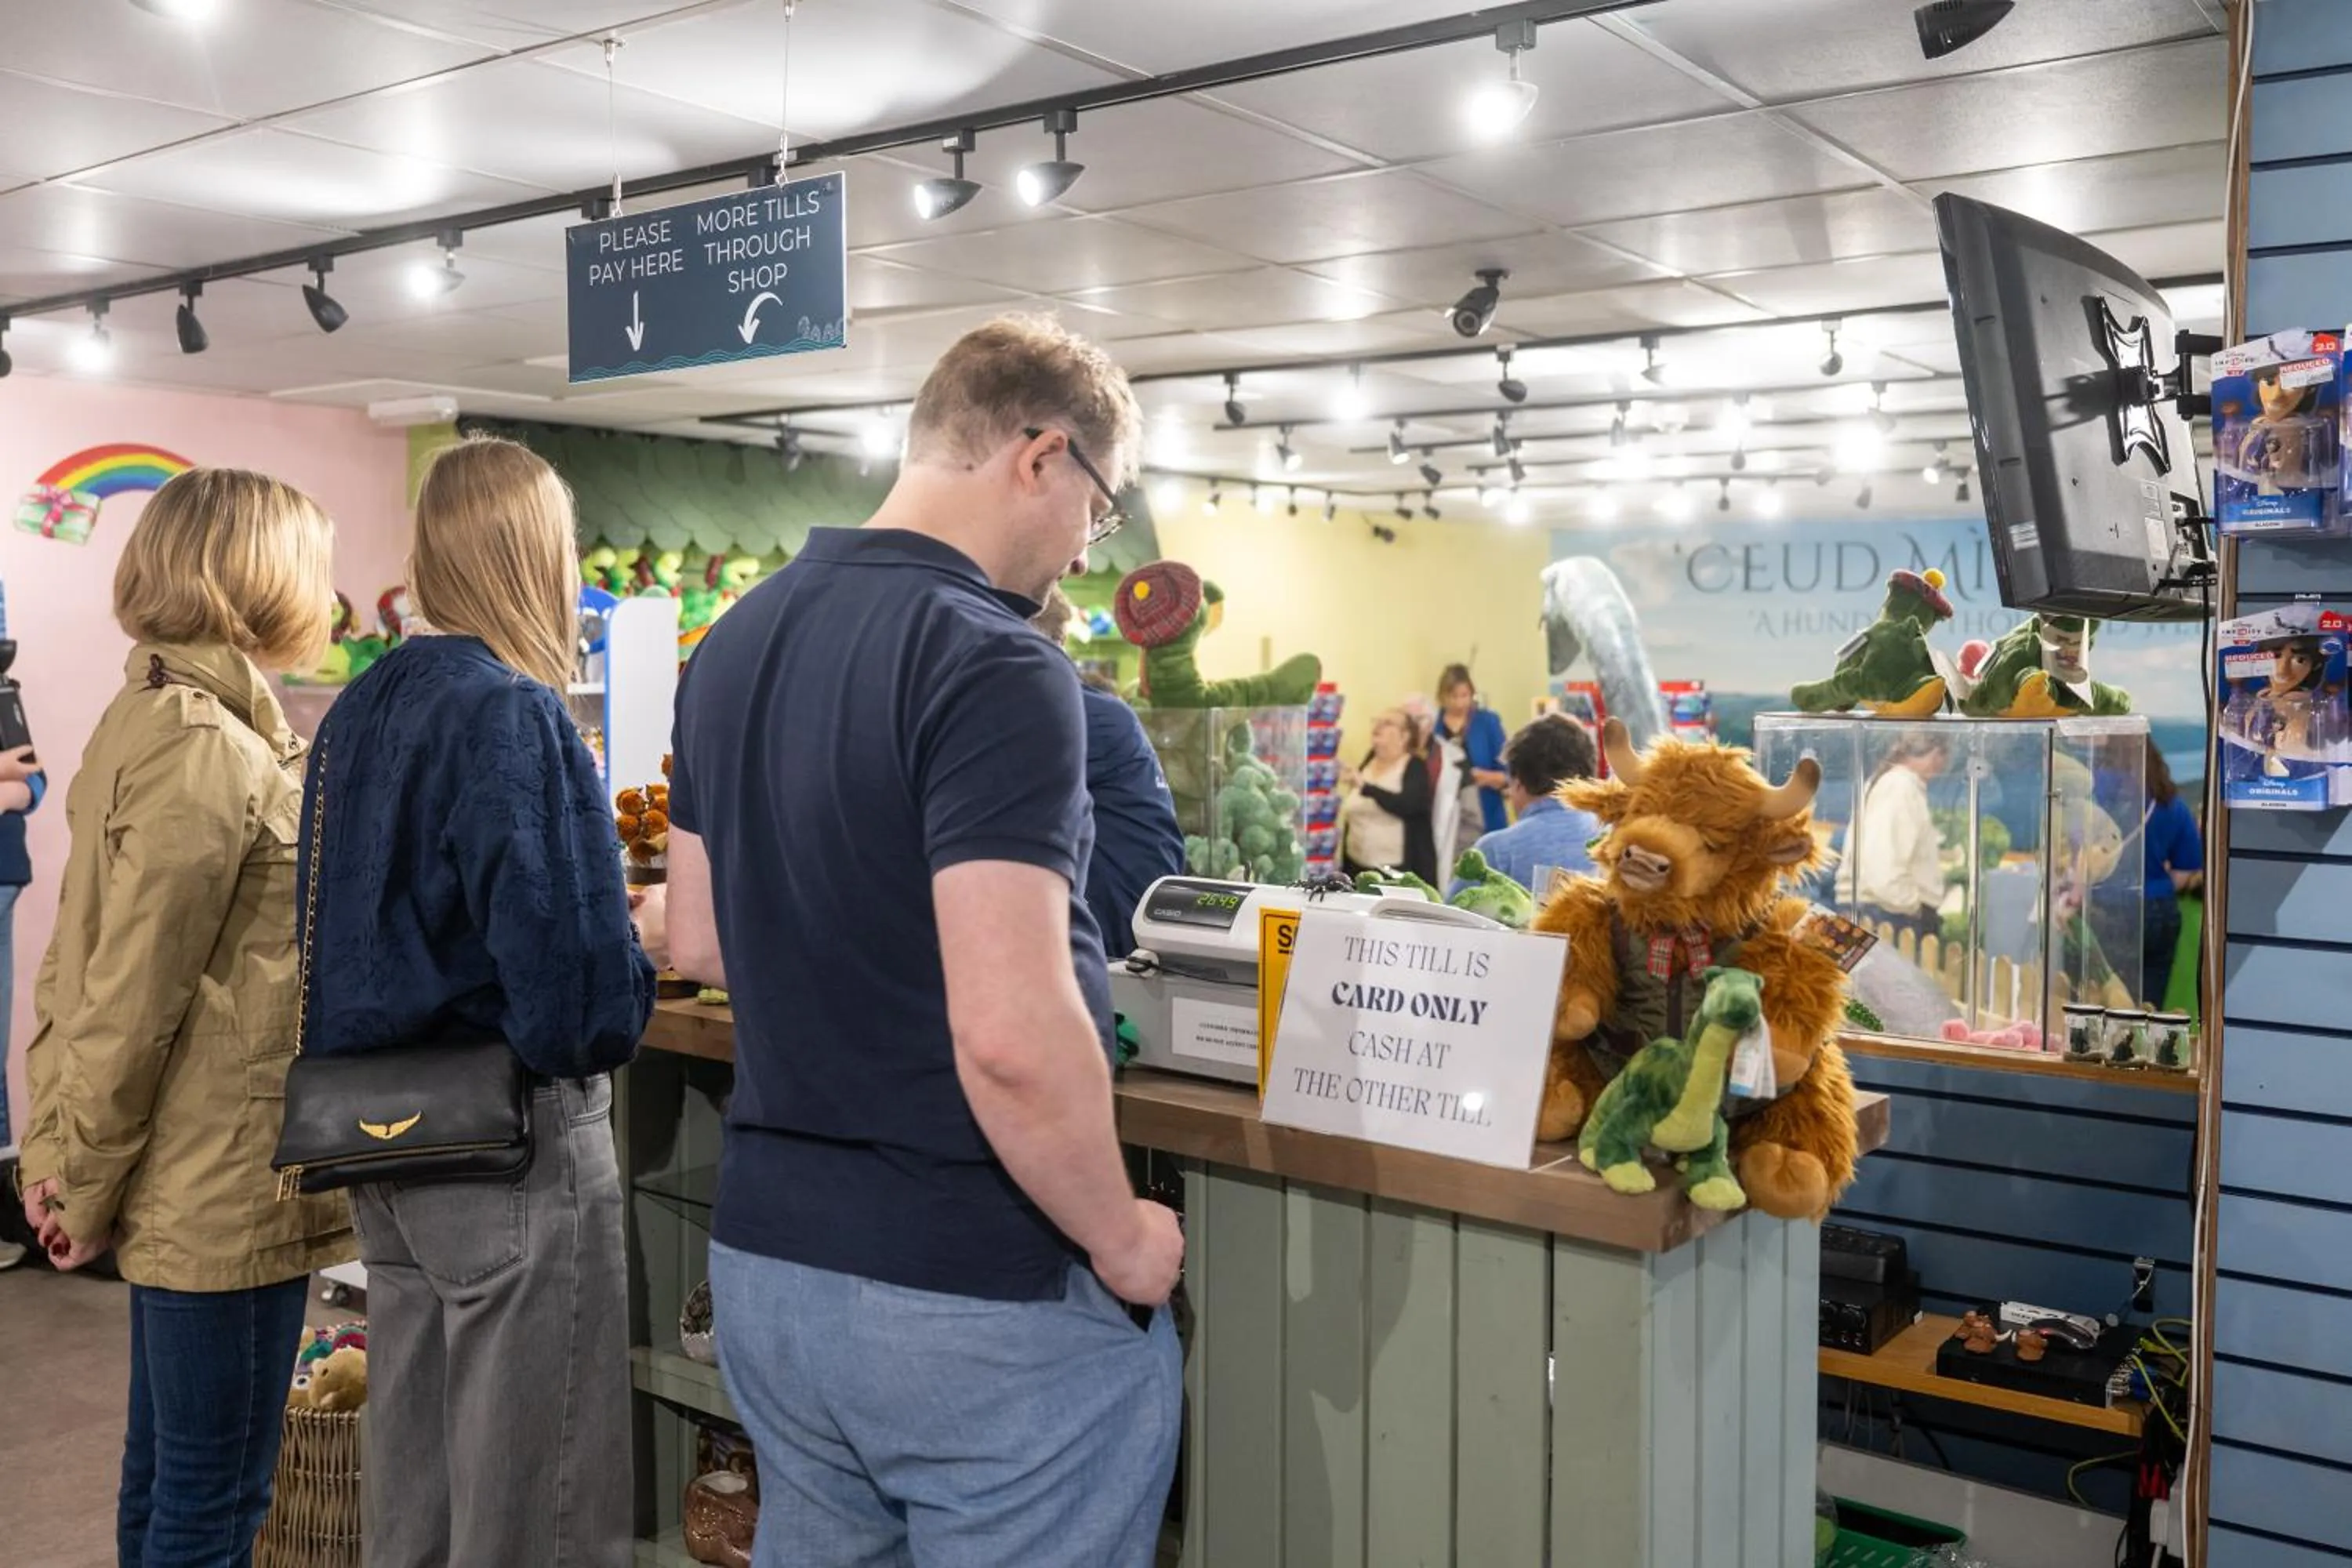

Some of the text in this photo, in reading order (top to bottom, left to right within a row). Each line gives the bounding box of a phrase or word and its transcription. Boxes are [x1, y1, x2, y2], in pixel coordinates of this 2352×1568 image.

[697, 191, 819, 235] MORE TILLS
[599, 220, 671, 253] PLEASE
[704, 225, 811, 265] THROUGH
[589, 249, 684, 286] PAY HERE
[728, 263, 787, 293] SHOP
[1896, 527, 1985, 602] MÌ
[1153, 909, 1181, 917] CASIO
[1277, 924, 1298, 948] S
[1345, 935, 1490, 978] THIS TILL IS
[1331, 980, 1489, 1026] CARD ONLY
[1347, 1029, 1452, 1069] CASH AT
[1294, 1067, 1493, 1127] THE OTHER TILL
